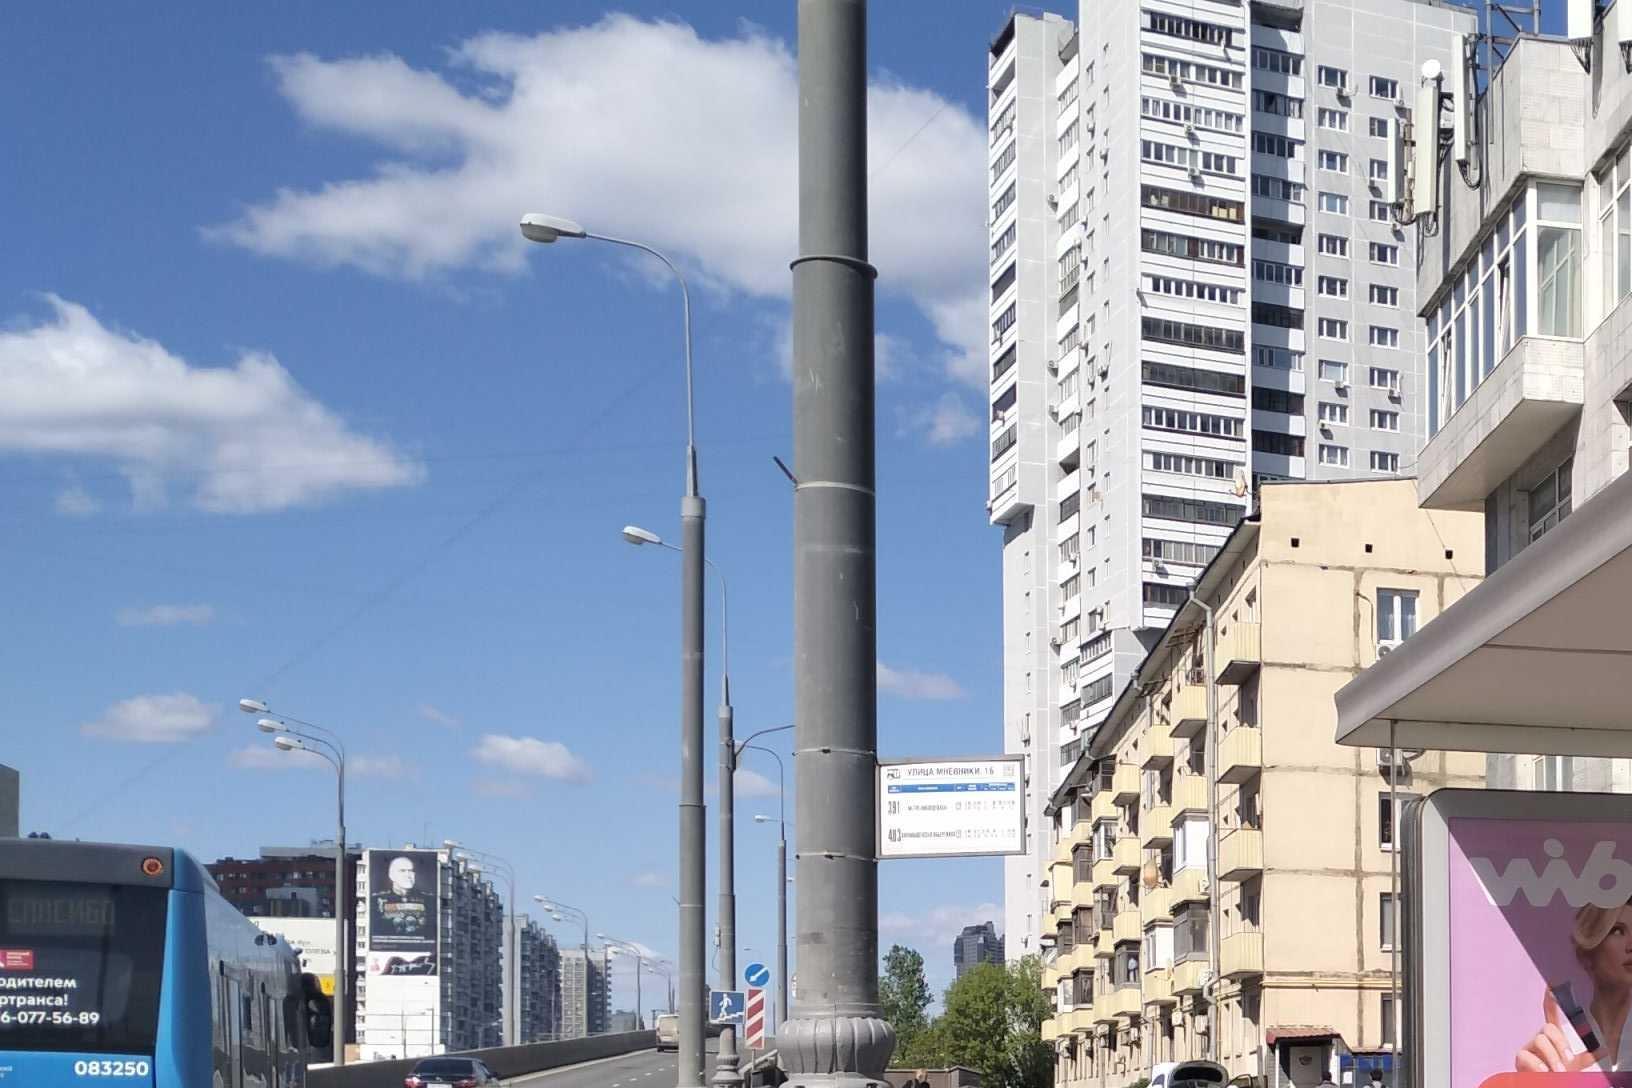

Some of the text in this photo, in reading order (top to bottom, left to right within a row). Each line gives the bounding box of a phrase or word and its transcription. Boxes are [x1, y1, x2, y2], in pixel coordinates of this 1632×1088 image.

[908, 767, 934, 776] УЛИЦА
[1, 1011, 100, 1024] 6-077-56-89
[74, 1060, 149, 1076] 083250
